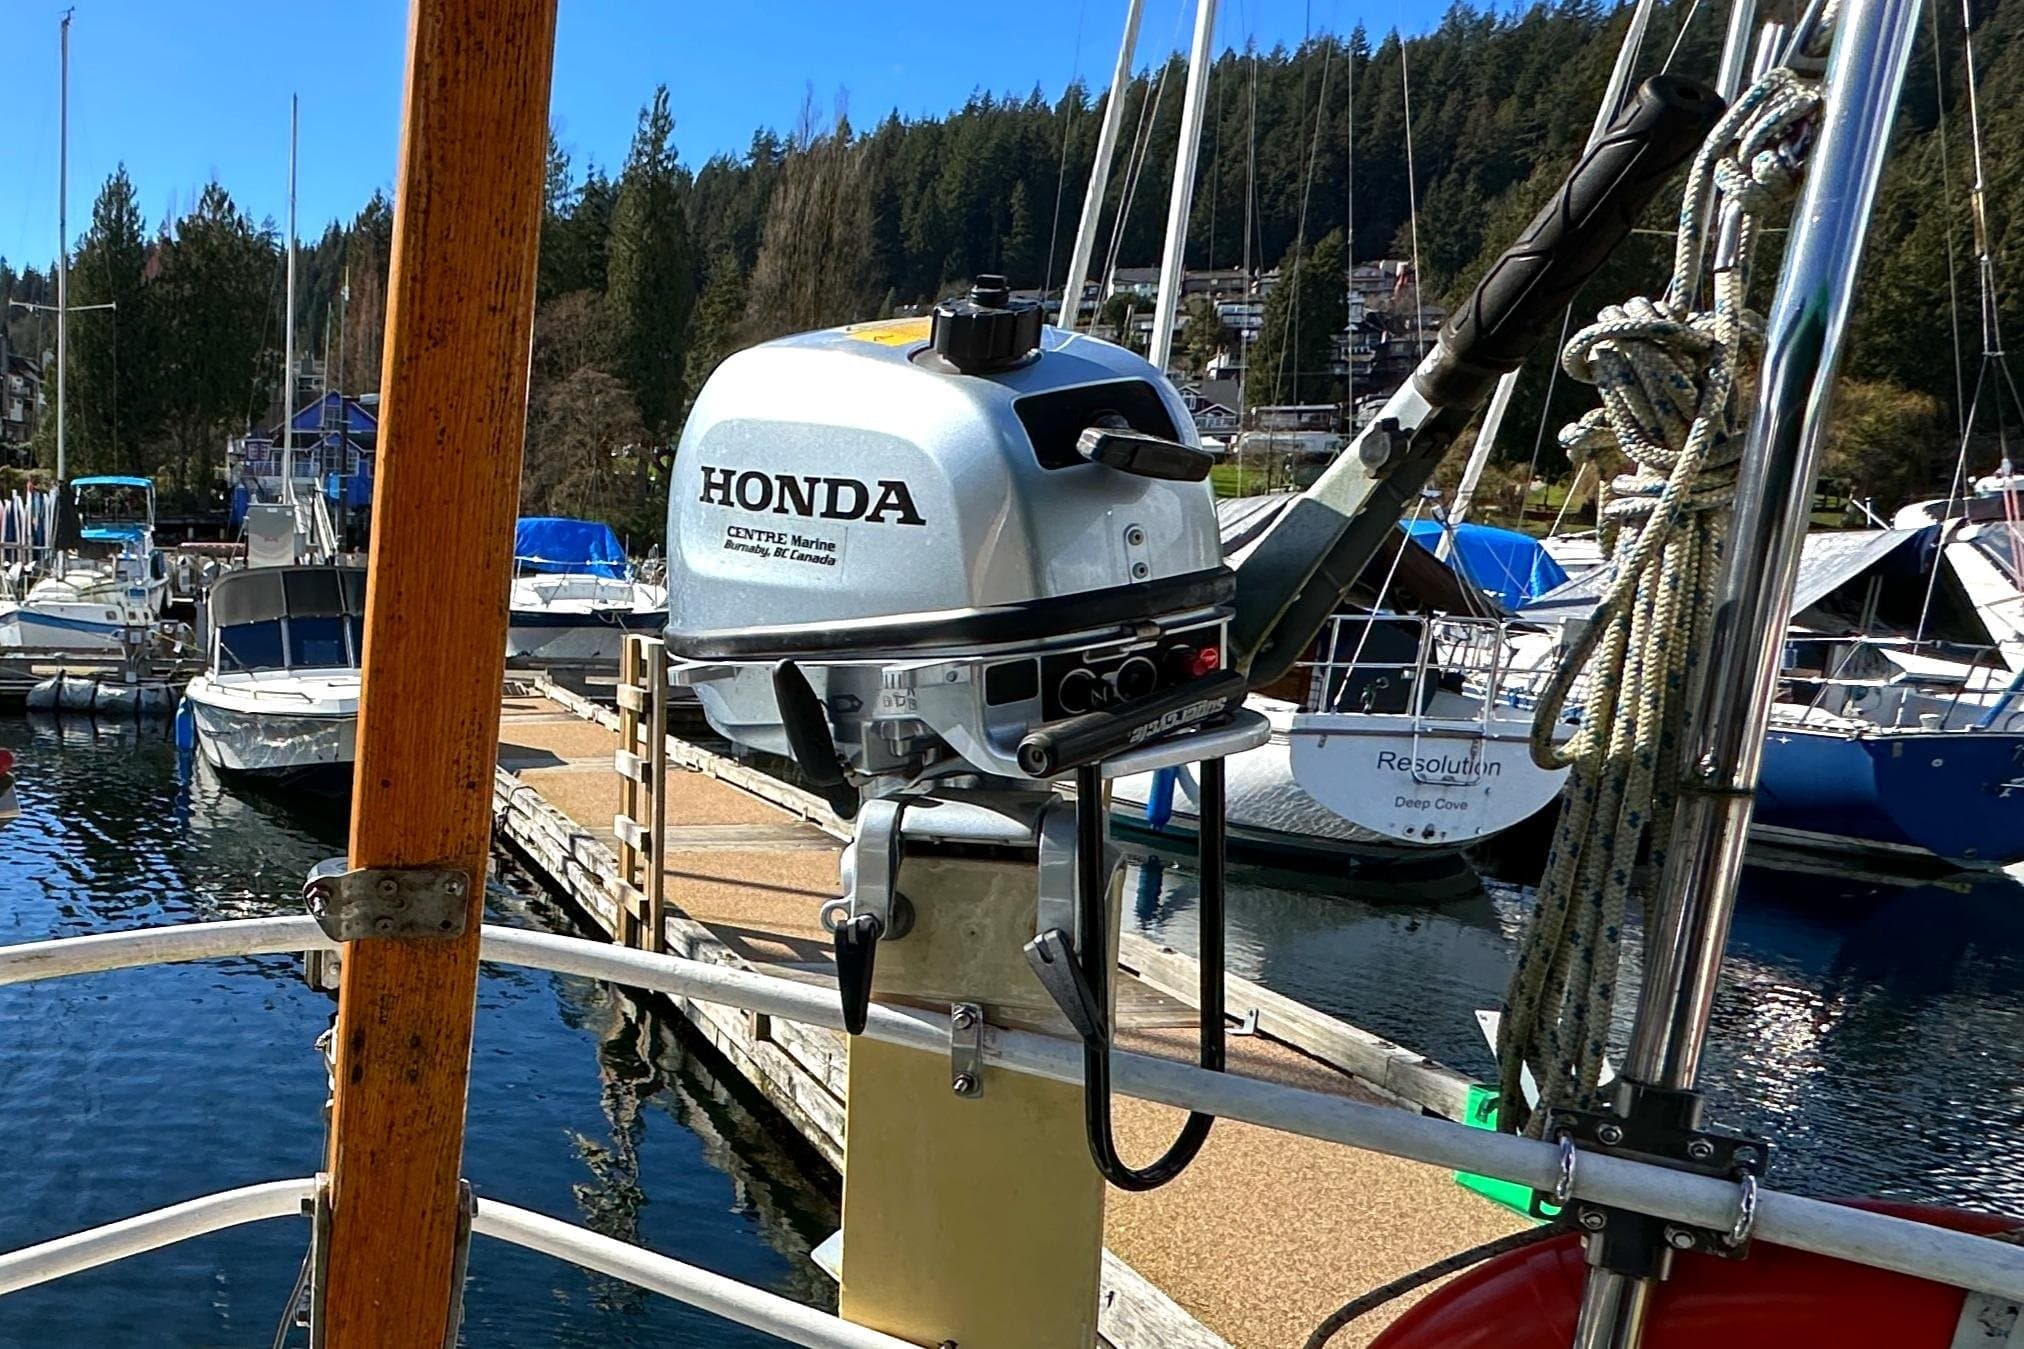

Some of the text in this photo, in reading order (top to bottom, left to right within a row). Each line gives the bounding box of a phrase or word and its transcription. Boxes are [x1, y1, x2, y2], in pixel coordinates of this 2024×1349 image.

[699, 465, 927, 526] HONDA
[727, 525, 836, 552] CENTRE Marine
[723, 539, 836, 566] Burnaby, BC Canada
[1377, 751, 1501, 776] Resolution
[1394, 796, 1468, 811] Deep Cove
